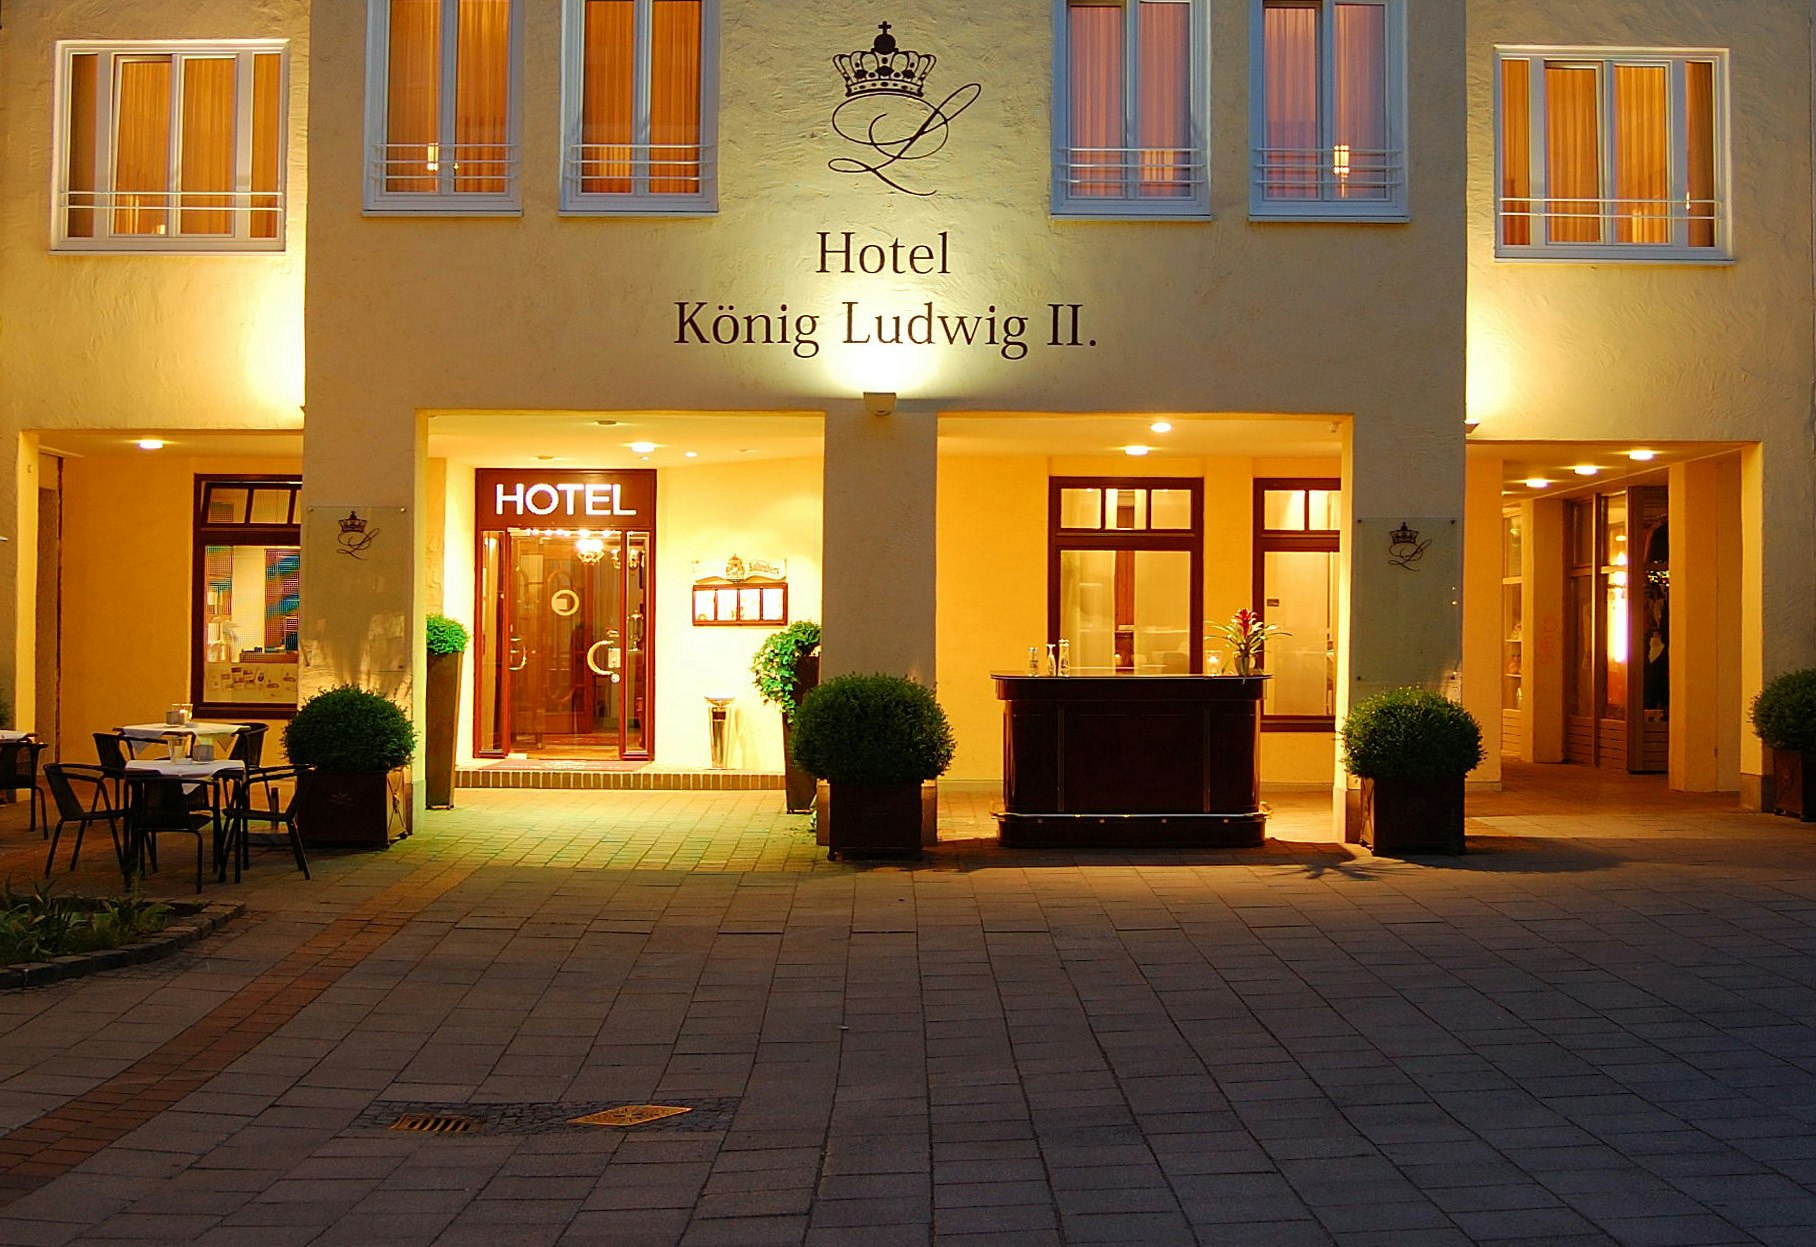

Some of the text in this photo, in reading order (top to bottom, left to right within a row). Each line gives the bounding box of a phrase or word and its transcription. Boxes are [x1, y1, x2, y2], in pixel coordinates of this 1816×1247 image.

[816, 231, 951, 274] Hotel
[674, 301, 1097, 360] König Ludwig II.
[495, 483, 637, 516] HOTEL
